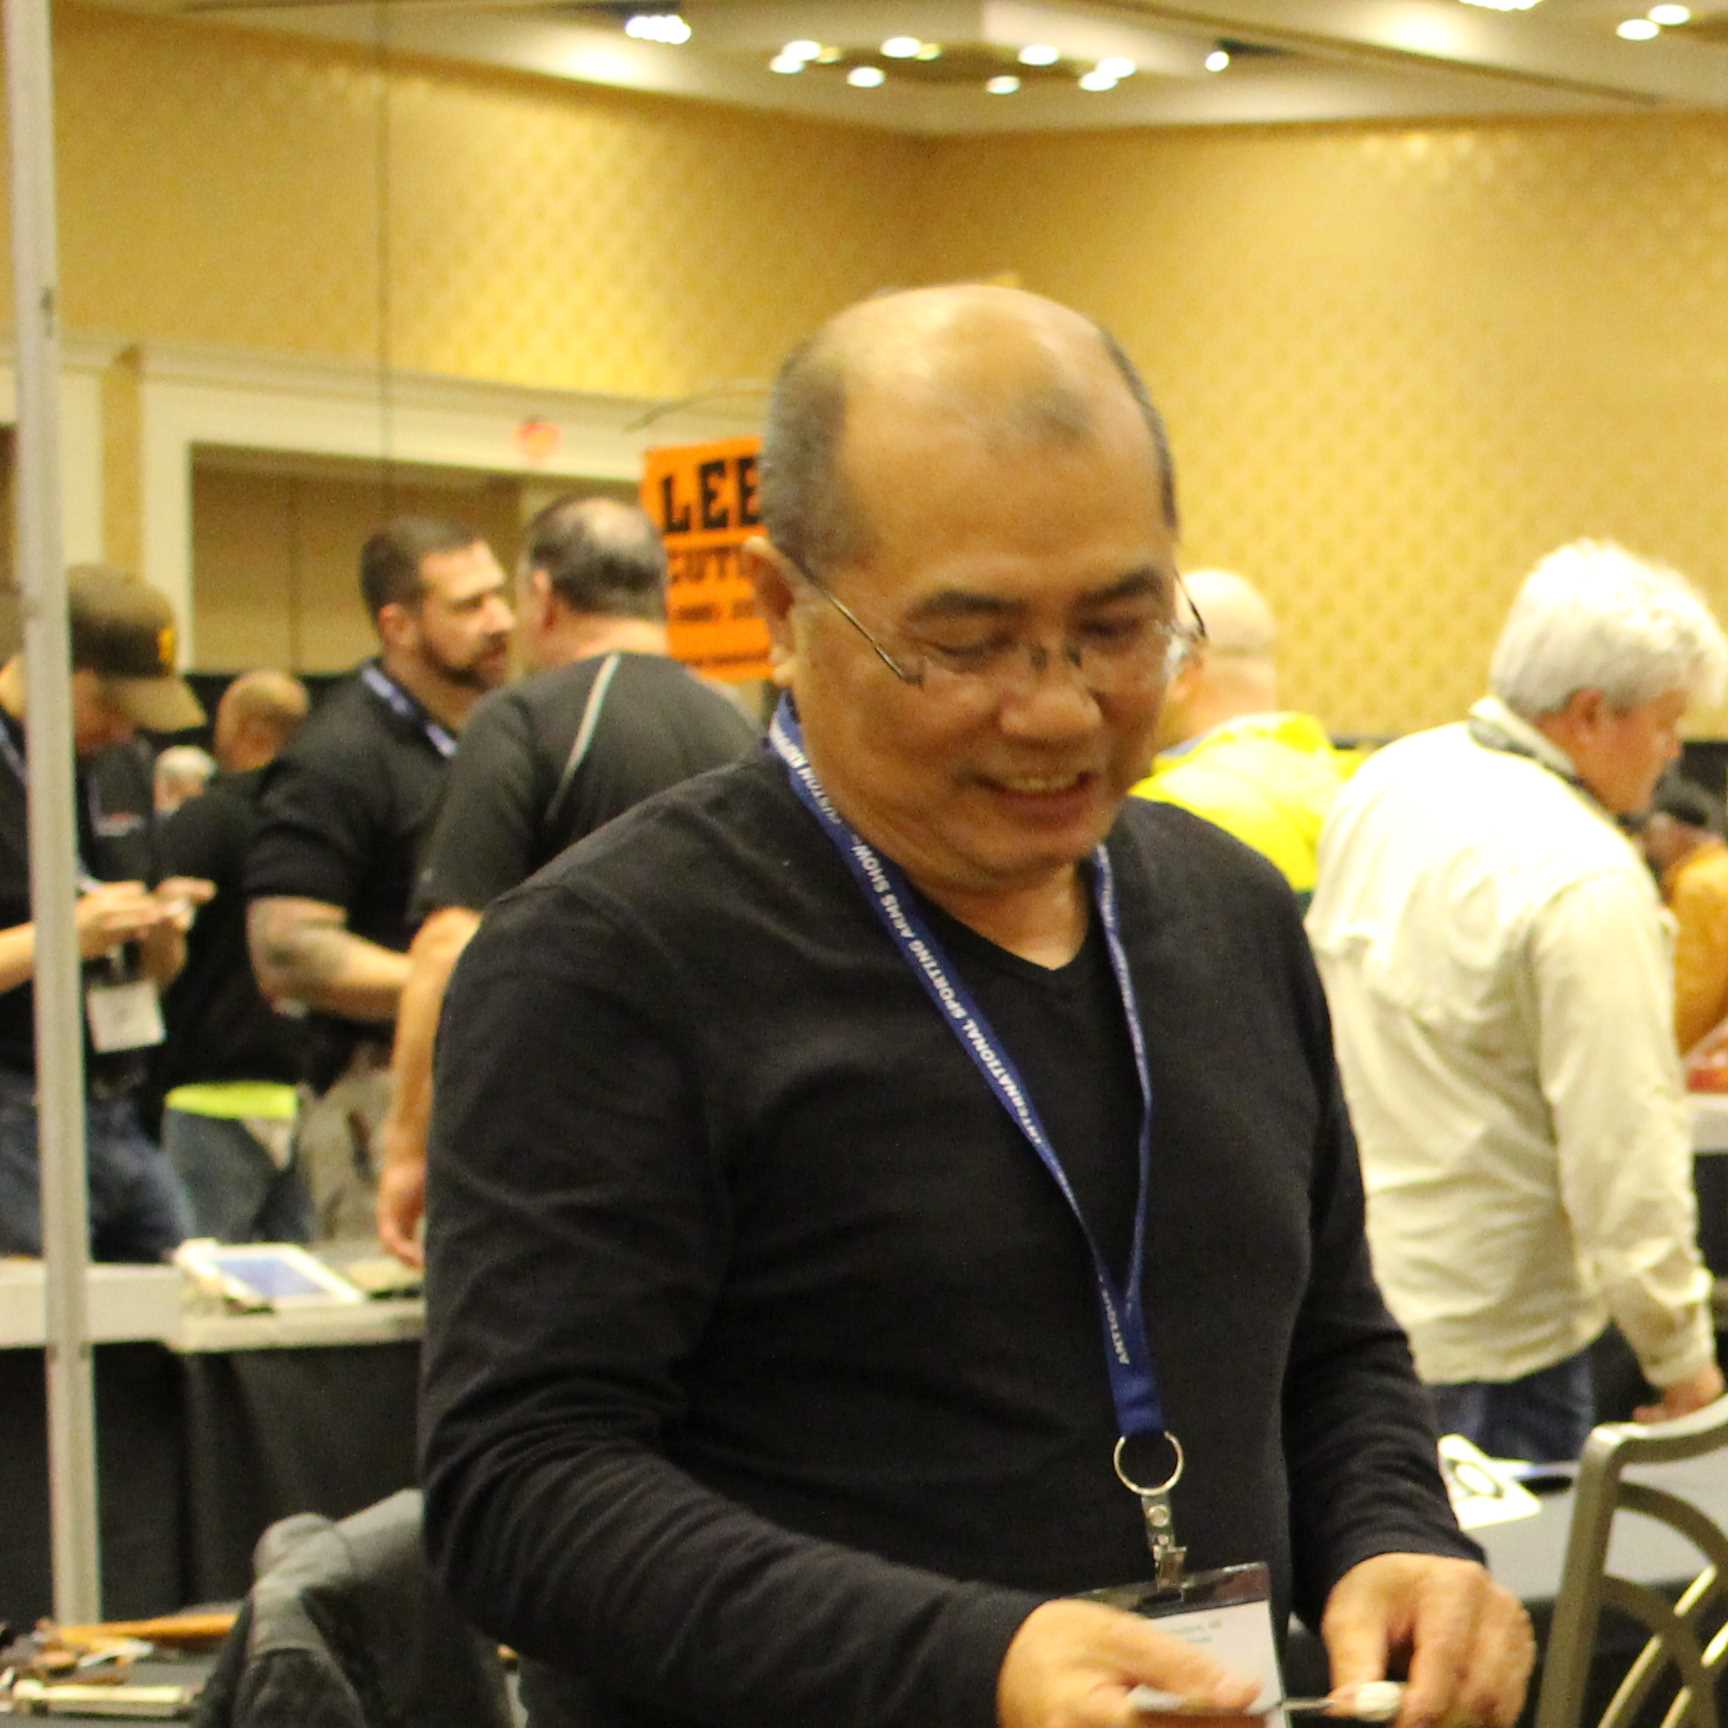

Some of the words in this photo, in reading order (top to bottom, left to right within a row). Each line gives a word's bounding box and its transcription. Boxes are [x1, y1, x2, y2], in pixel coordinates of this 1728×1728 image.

[880, 894, 914, 939] ARMS
[909, 940, 967, 1019] SPORTING
[962, 1018, 1045, 1144] INTERNATIONAL
